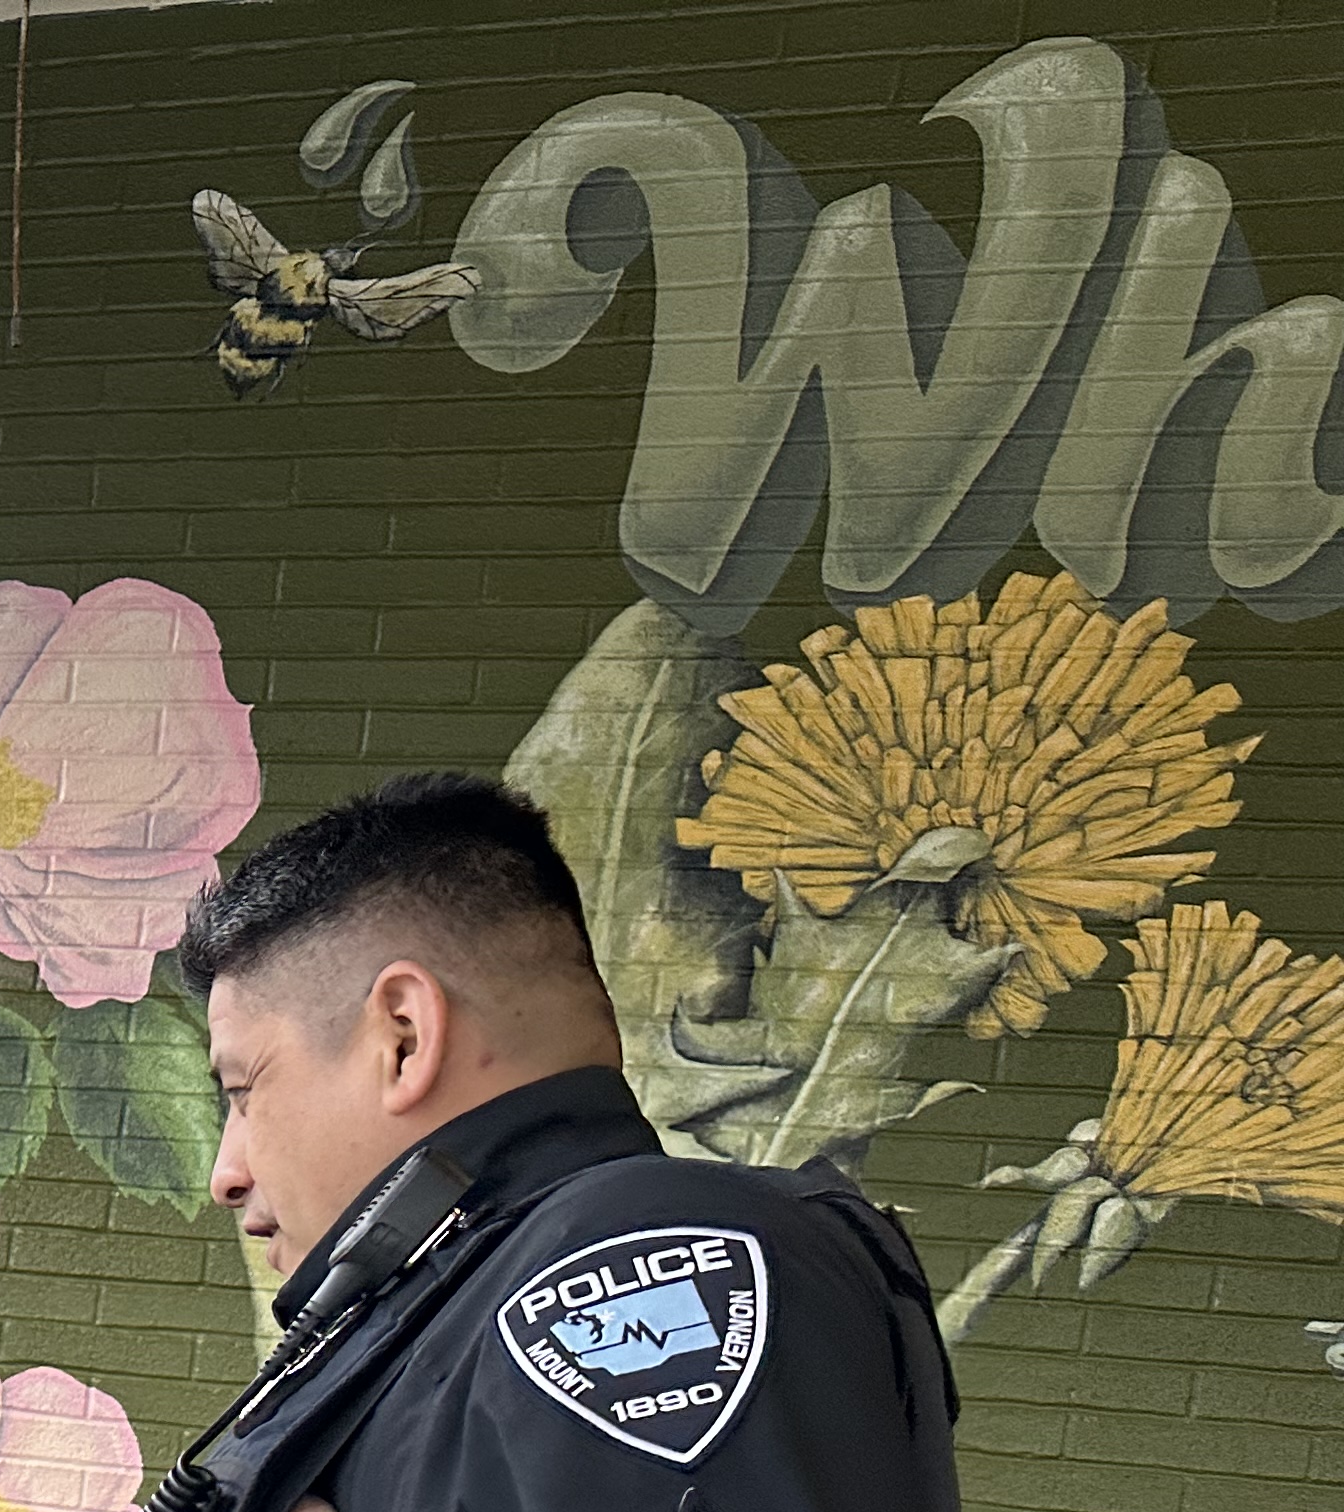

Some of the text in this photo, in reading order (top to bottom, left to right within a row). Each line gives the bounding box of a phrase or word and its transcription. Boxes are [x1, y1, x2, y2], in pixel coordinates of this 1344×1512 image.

[520, 1238, 733, 1325] POLICE
[525, 1290, 754, 1397] MOUNT VERNON
[610, 1382, 723, 1422] 1890
